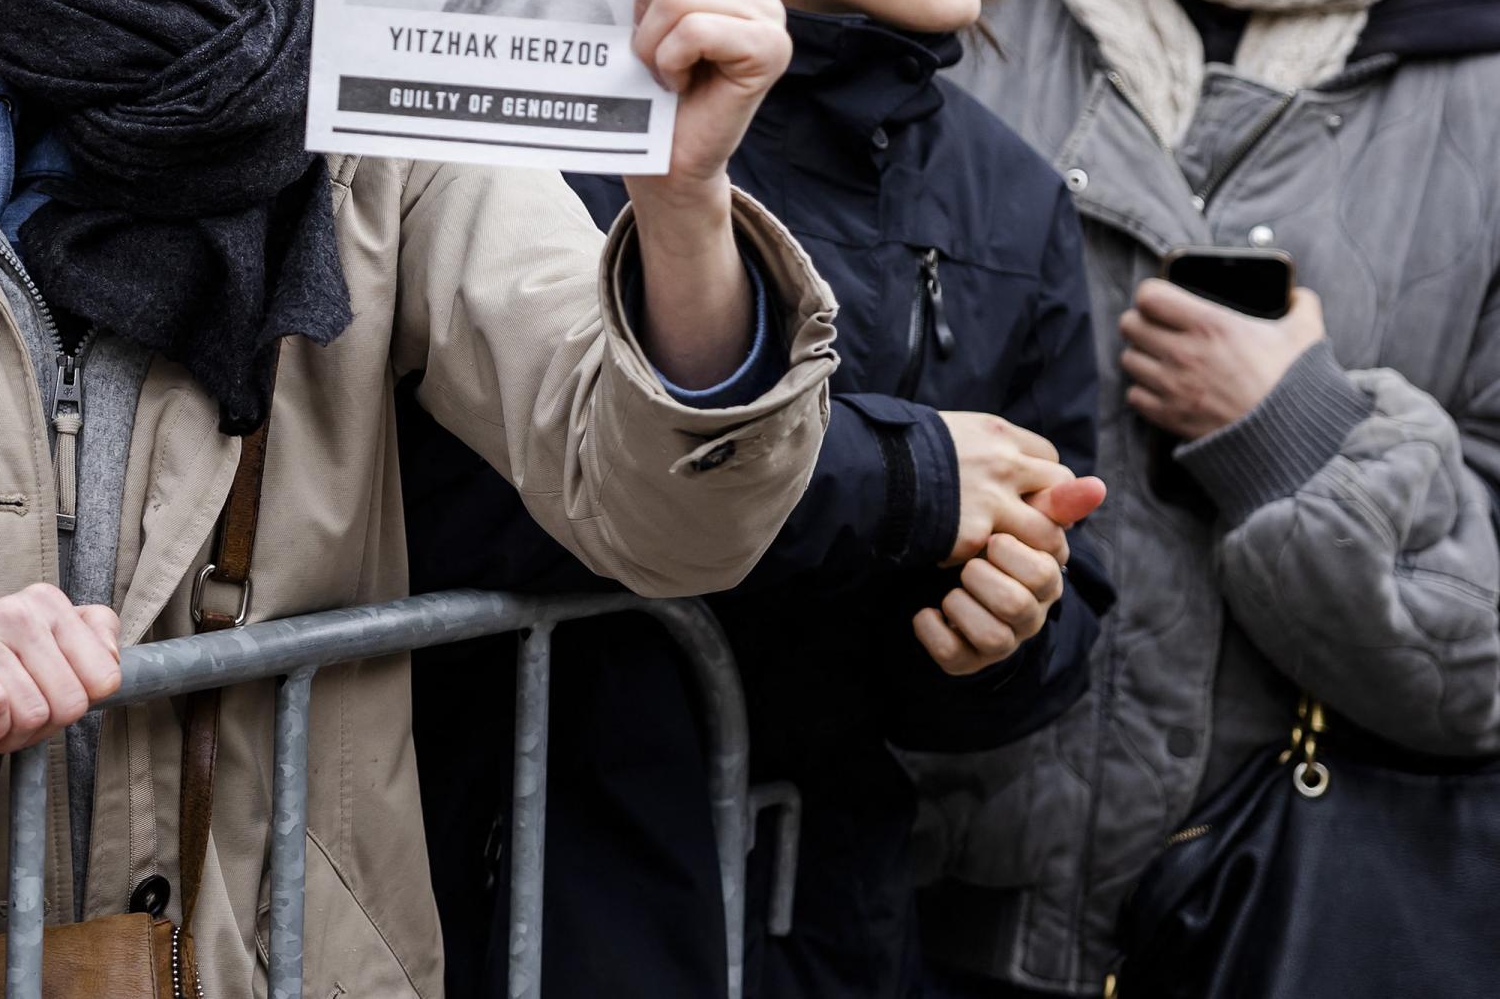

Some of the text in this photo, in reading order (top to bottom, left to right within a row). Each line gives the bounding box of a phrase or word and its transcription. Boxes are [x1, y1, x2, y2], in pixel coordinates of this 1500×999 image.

[389, 25, 610, 67] YITZHAK HERZOG
[389, 87, 599, 123] GUILTY OF GENOCIDE
